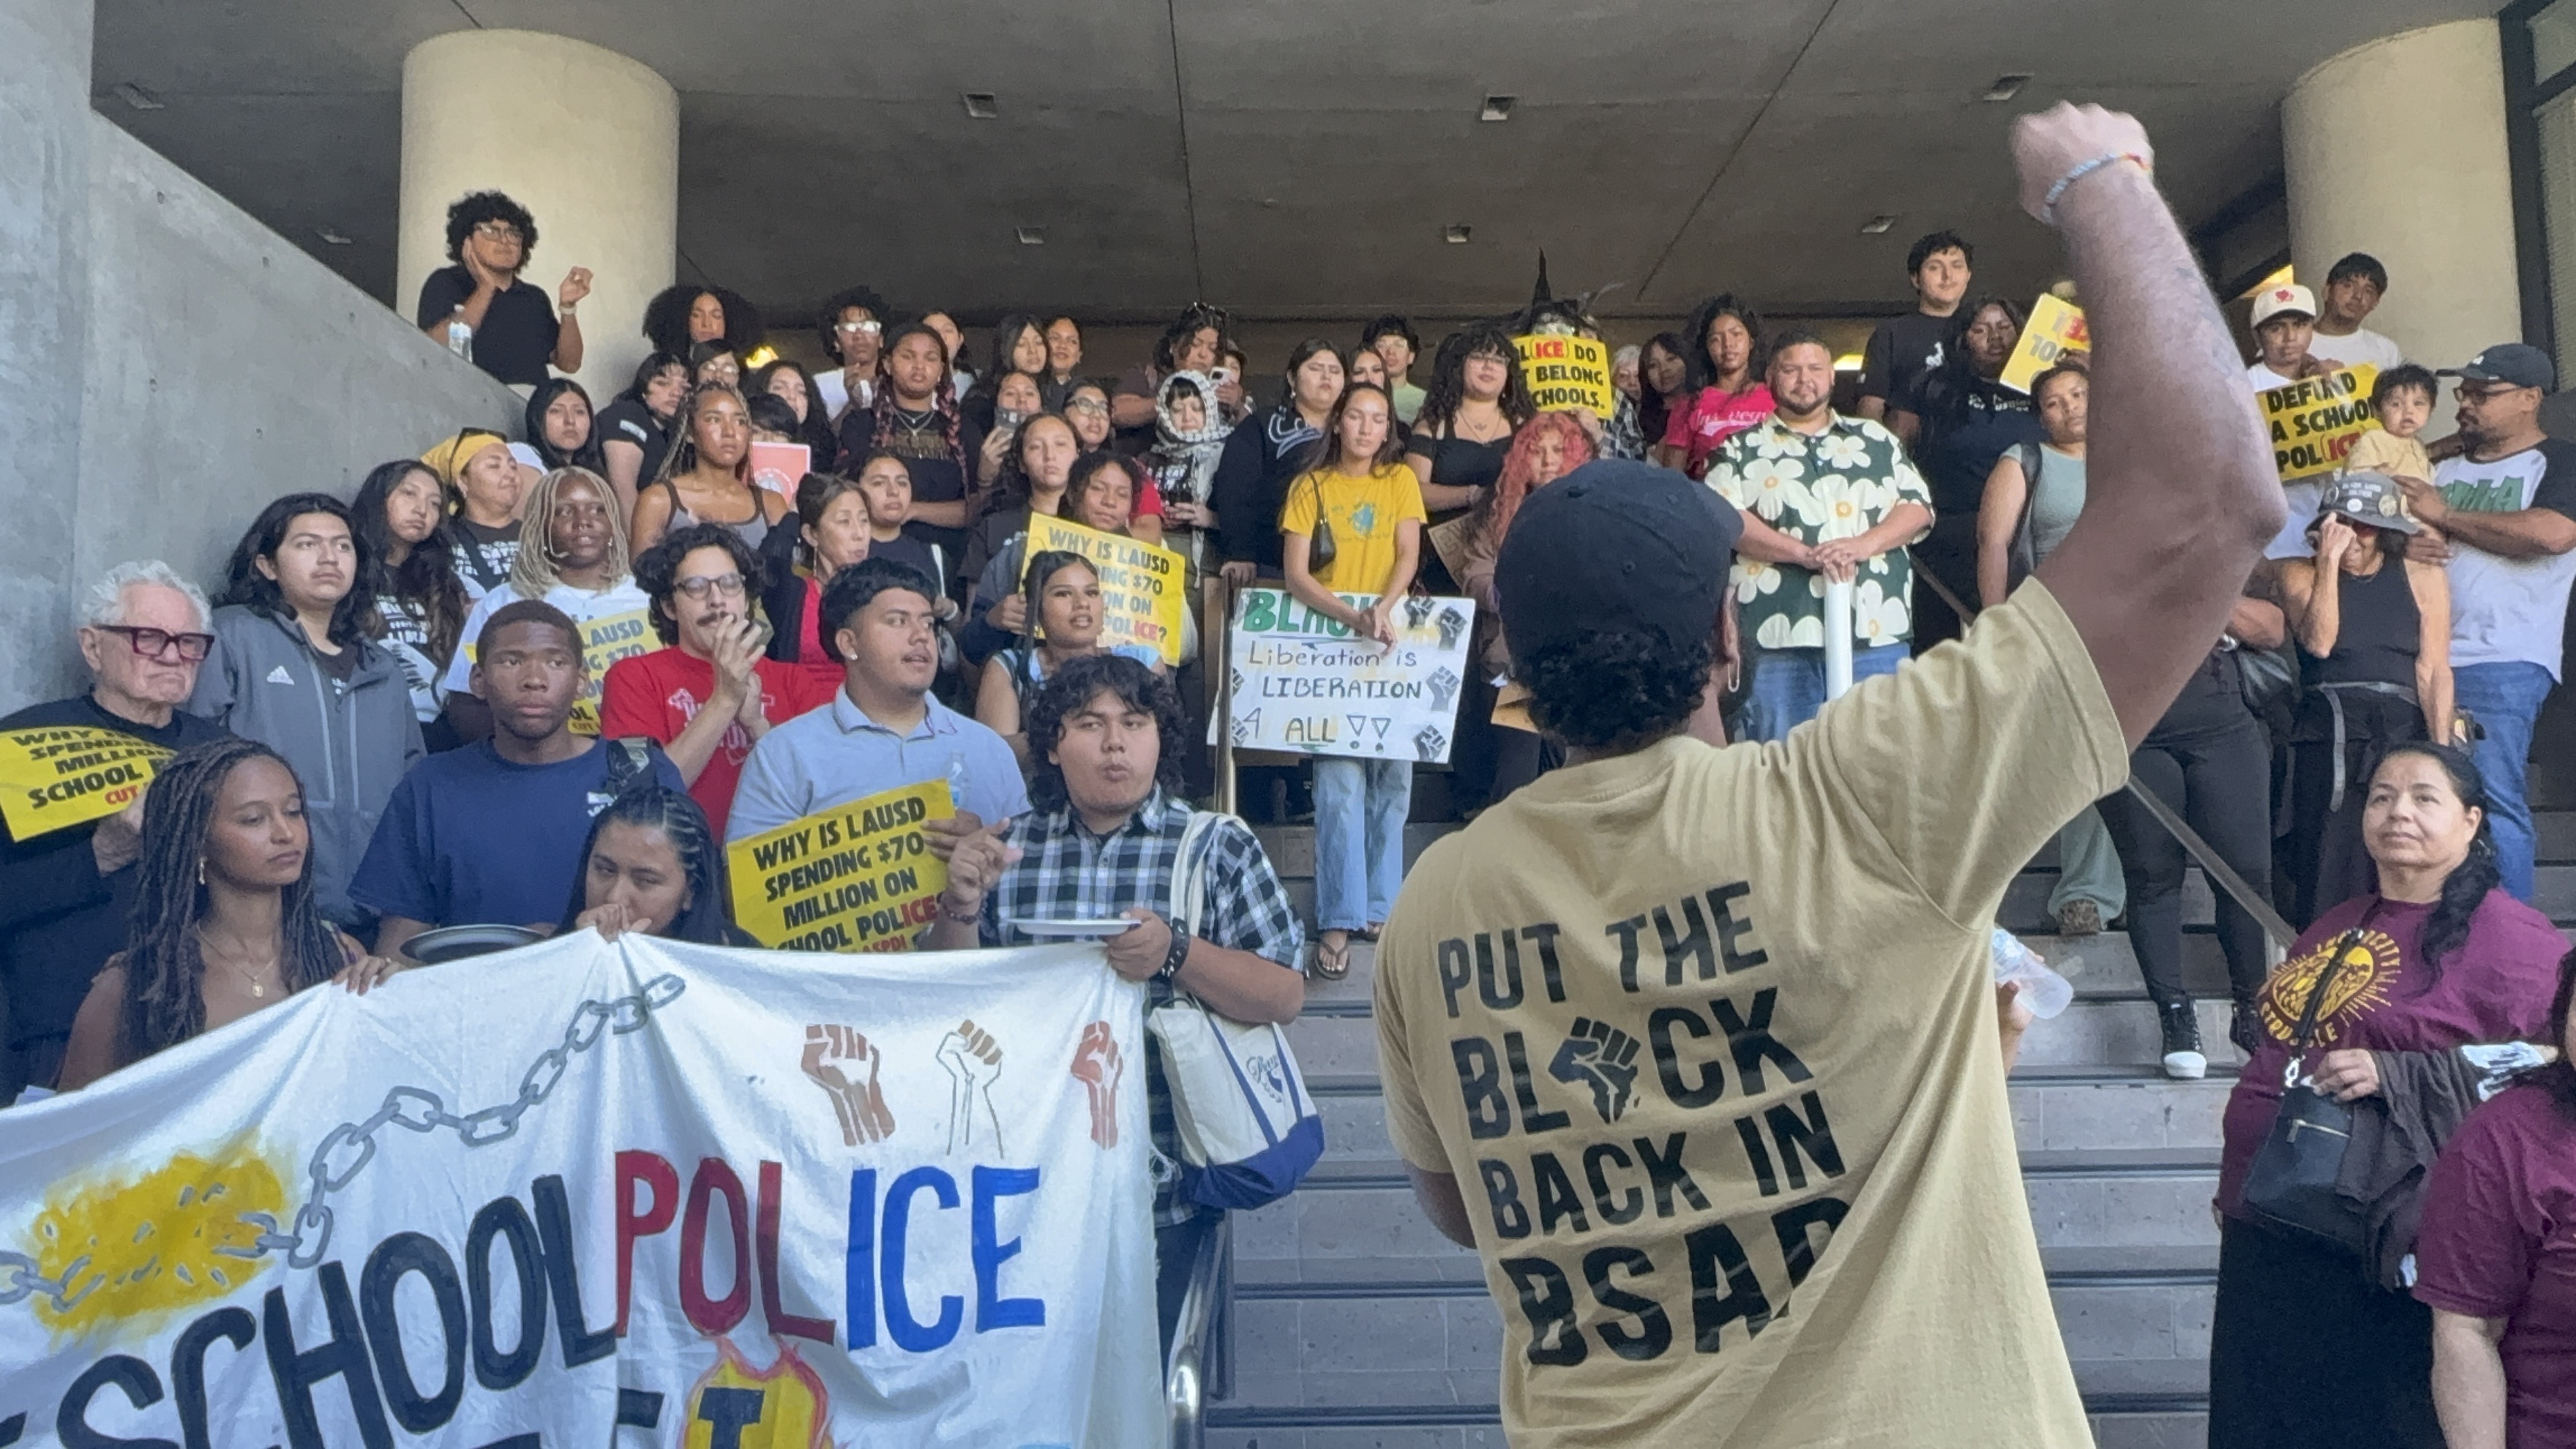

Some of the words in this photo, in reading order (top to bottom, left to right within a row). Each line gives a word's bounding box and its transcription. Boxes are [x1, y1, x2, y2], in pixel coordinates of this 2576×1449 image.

[1574, 344, 1597, 363] DO
[1536, 364, 1603, 386] BELONG
[1532, 387, 1605, 409] CHOOLS.
[2272, 420, 2289, 443] A
[1049, 526, 1093, 554] WHY
[1096, 540, 1112, 561] IS
[1117, 545, 1169, 575] LAUSD
[1133, 574, 1163, 596] $70
[1129, 596, 1152, 616] ON
[584, 619, 644, 648] AUSD
[1248, 640, 1380, 667] Liberation
[1396, 650, 1418, 667] is
[1262, 675, 1422, 699] LIBERATION
[1284, 716, 1336, 744] ALL
[27, 763, 144, 810] SCHOOL
[105, 785, 139, 806] CUT
[752, 828, 812, 872] WHY
[818, 820, 841, 850] IS
[846, 796, 926, 841] LAUSD
[765, 845, 872, 903] SPENDING
[877, 831, 924, 864] $70
[783, 879, 879, 931] MILLION
[883, 866, 918, 898] ON
[1438, 923, 1566, 1019] PUT
[1606, 881, 1768, 993] THE
[2260, 1002, 2338, 1048] STRULE
[1478, 1131, 1712, 1240] BACK
[1734, 1090, 1846, 1198] IN
[615, 1149, 1045, 1352] POLICE
